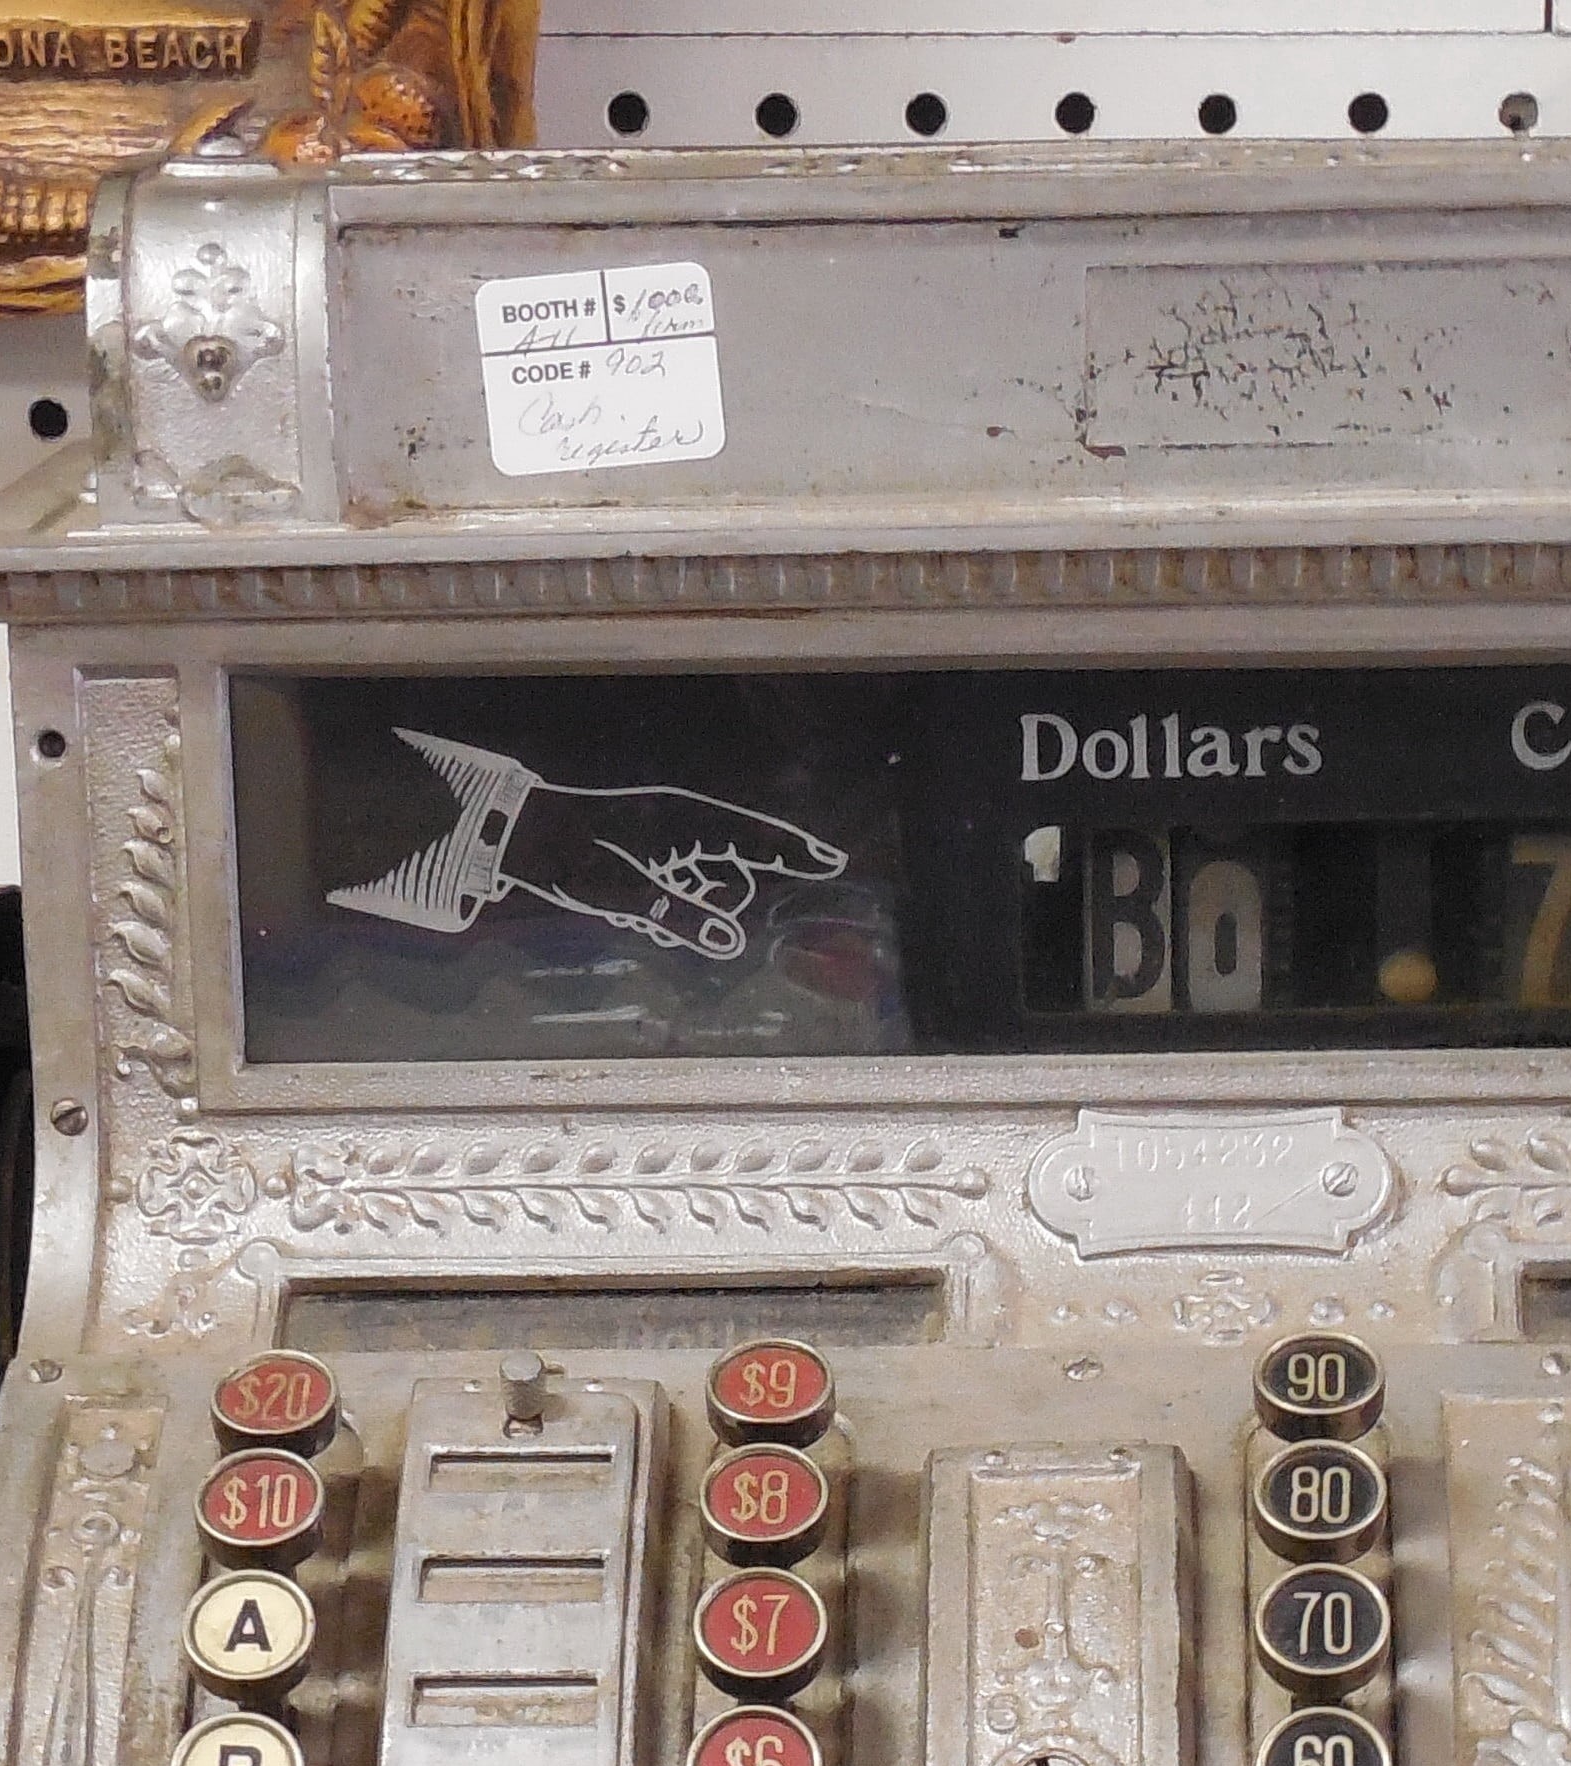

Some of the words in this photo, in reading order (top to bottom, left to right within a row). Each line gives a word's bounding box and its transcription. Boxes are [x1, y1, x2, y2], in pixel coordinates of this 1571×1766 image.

[104, 28, 249, 70] BEACH
[502, 299, 579, 323] BOOTH
[583, 298, 597, 317] #
[511, 361, 574, 385] CODE
[578, 360, 592, 380] #
[606, 347, 666, 377] 902
[1020, 712, 1323, 782] Dollars
[234, 1372, 312, 1422] $20
[739, 1359, 797, 1409] $9
[1287, 1352, 1347, 1403] 90
[220, 1472, 298, 1530] $10
[731, 1469, 790, 1525] $8
[1289, 1465, 1351, 1524] 80
[224, 1599, 272, 1653] A
[731, 1593, 790, 1657] $7
[1292, 1591, 1353, 1656] 70
